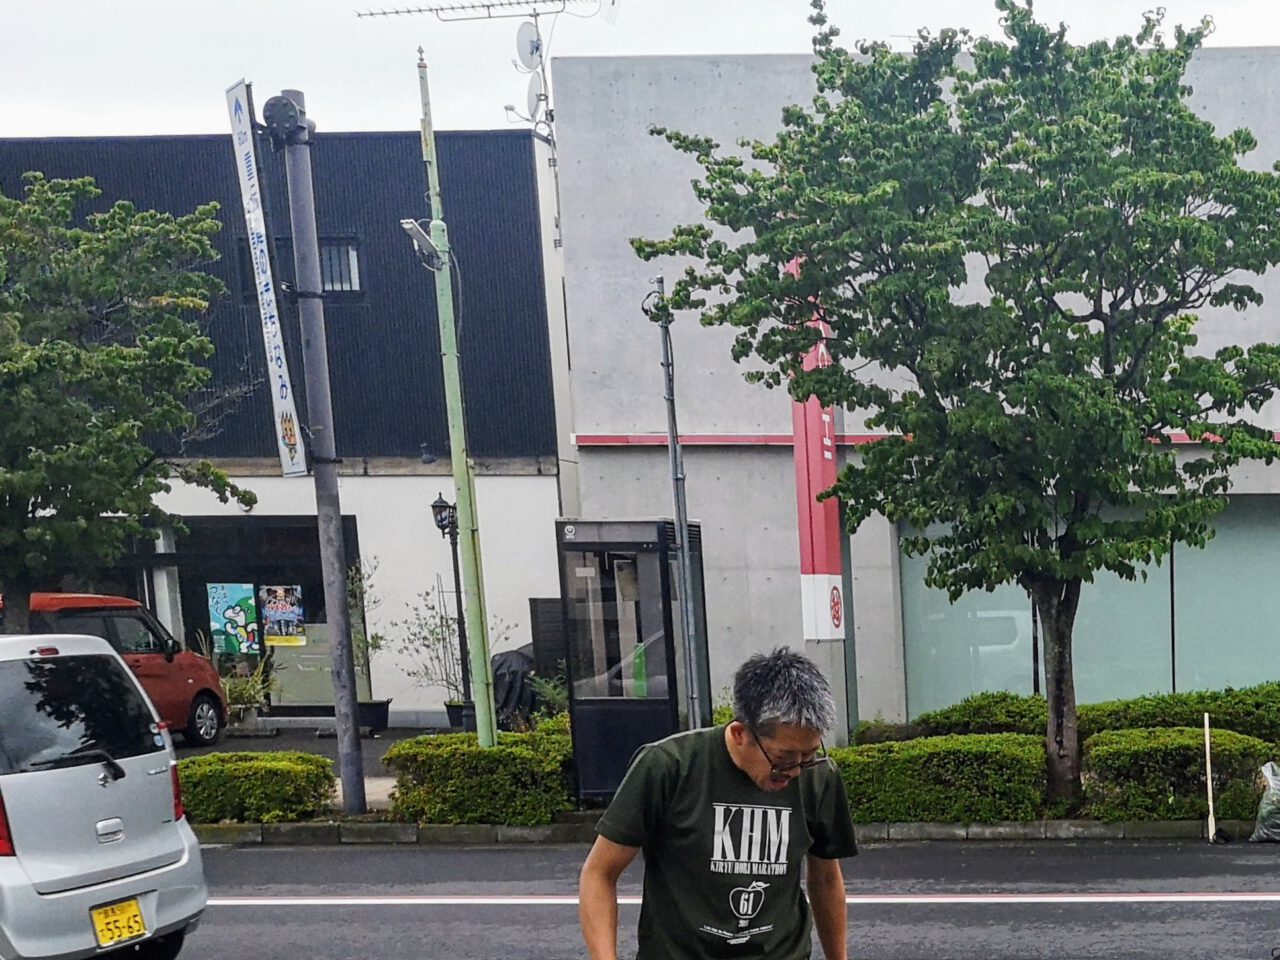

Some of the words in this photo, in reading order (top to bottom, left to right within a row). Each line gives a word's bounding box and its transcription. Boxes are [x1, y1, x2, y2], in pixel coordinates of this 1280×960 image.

[710, 805, 792, 863] KHM
[710, 860, 734, 874] KIRYU
[752, 863, 788, 876] MARATHON
[739, 892, 755, 915] 61
